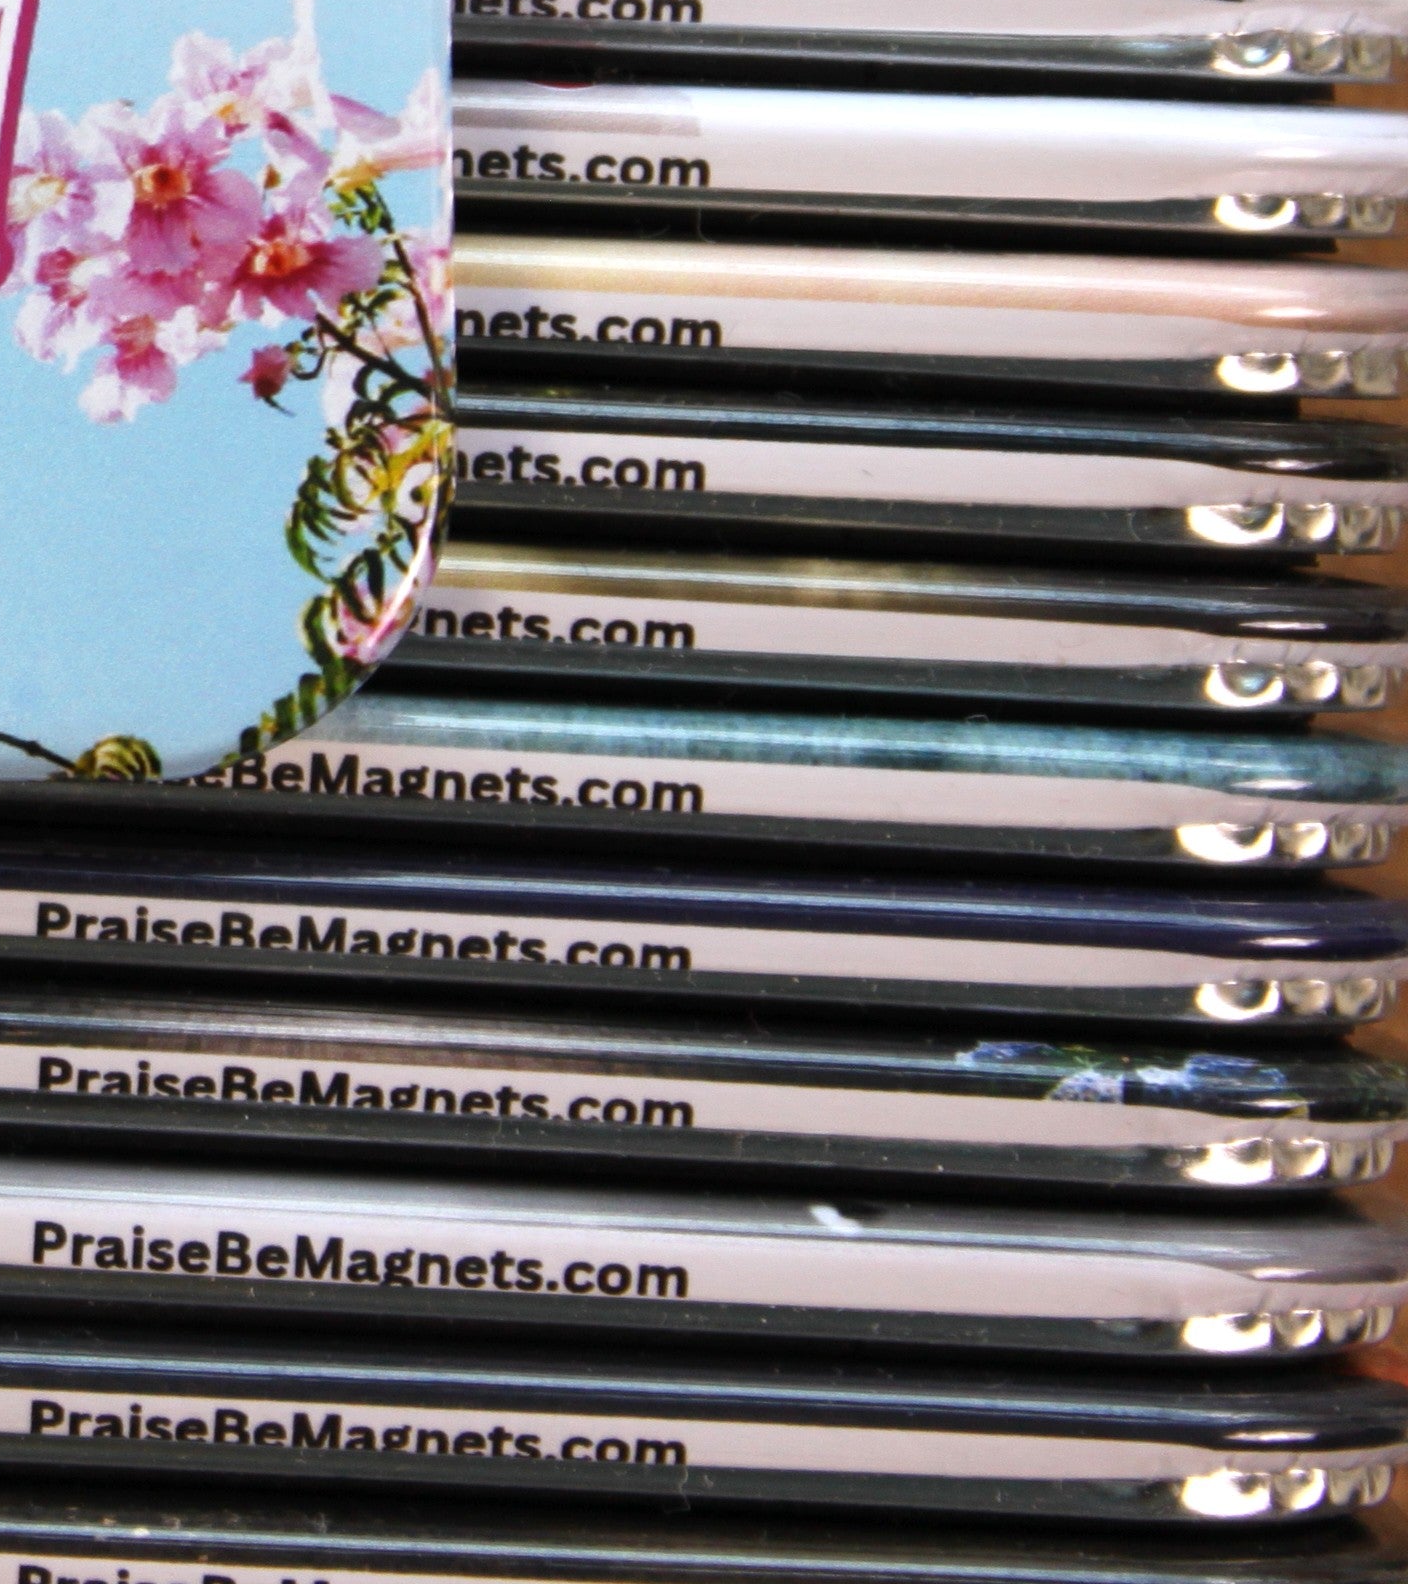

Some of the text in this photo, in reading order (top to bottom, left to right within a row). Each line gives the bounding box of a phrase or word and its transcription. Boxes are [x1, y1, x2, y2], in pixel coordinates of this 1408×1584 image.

[412, 606, 695, 648] nets.com
[35, 902, 692, 970] PraiseBeMagnets.com
[38, 1056, 694, 1126] PraiseBeMagnets.com
[33, 1220, 688, 1298] PraiseBeMagnets.com
[30, 1400, 687, 1465] PraiseBeMagnets.com
